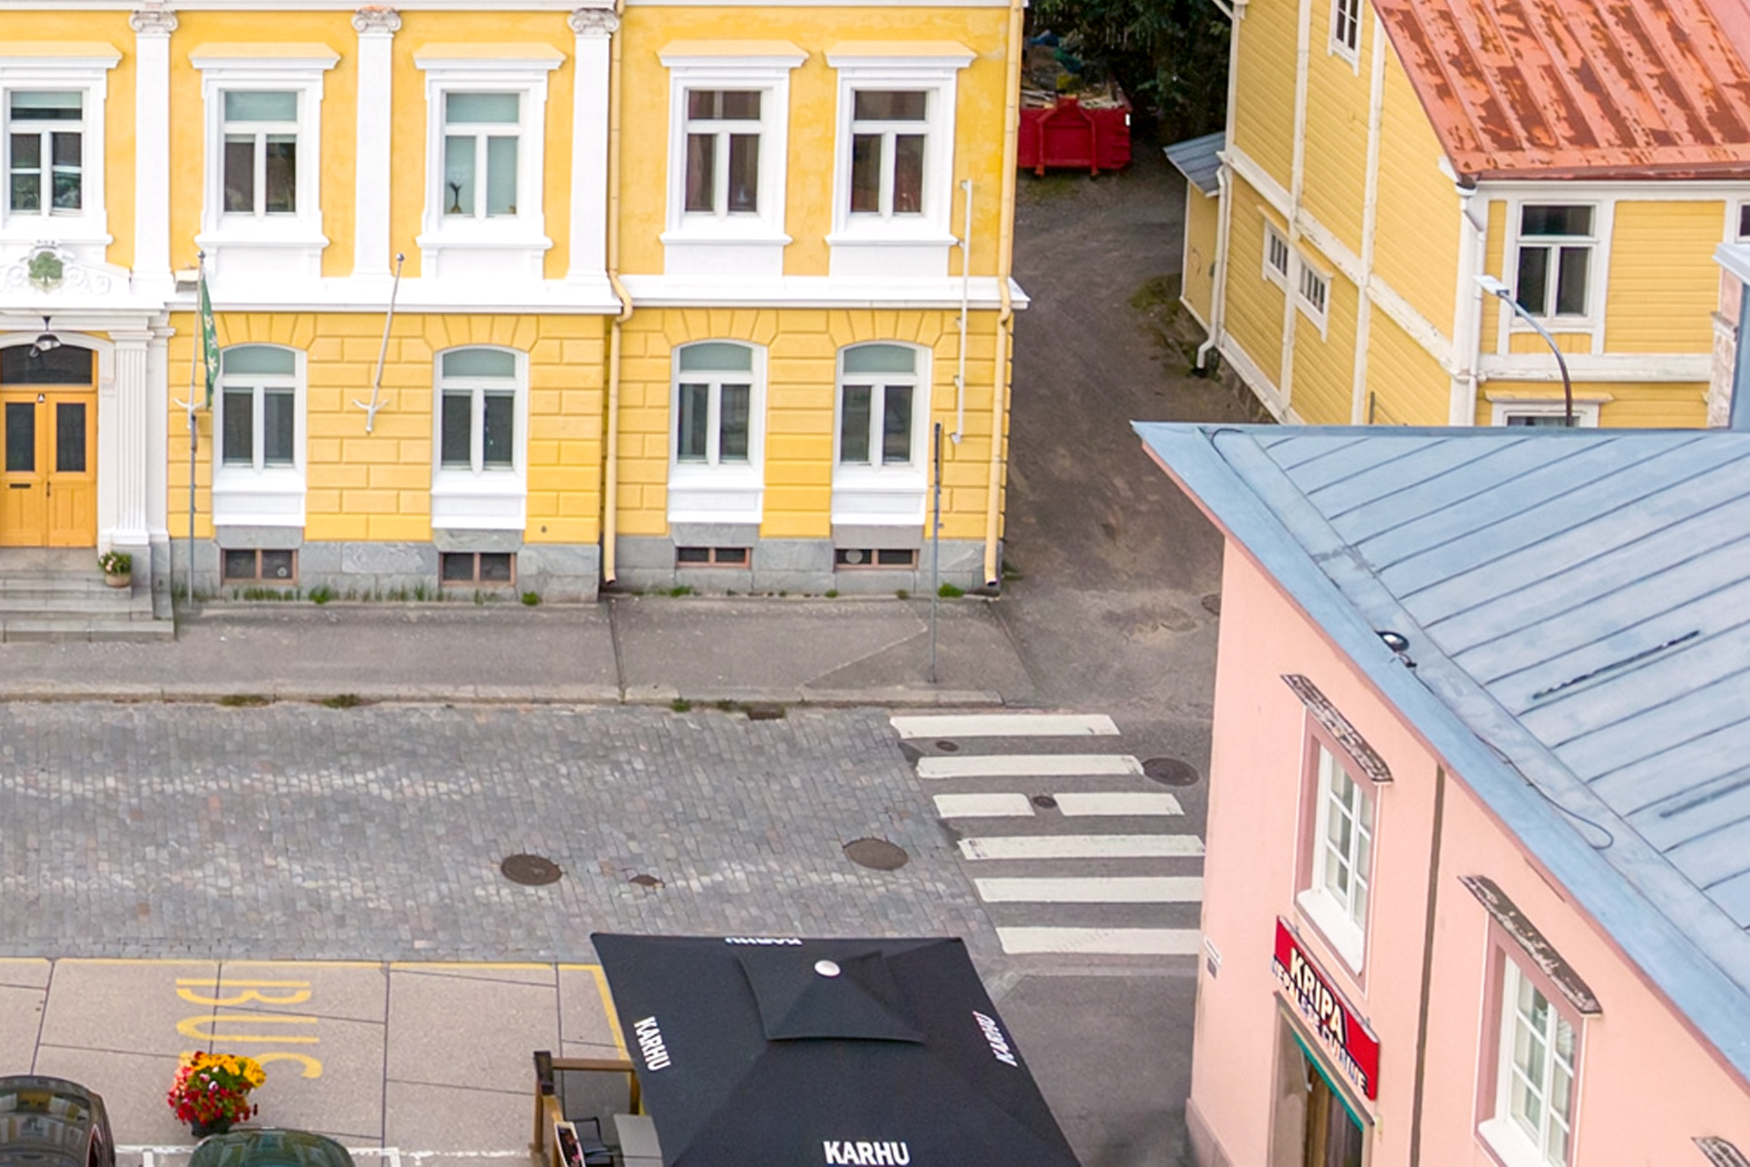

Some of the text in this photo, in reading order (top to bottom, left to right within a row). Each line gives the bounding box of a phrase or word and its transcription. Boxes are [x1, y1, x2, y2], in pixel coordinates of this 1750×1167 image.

[1290, 946, 1346, 1045] KRIPA
[633, 1015, 672, 1071] KARHU
[823, 1140, 910, 1166] KARHU
